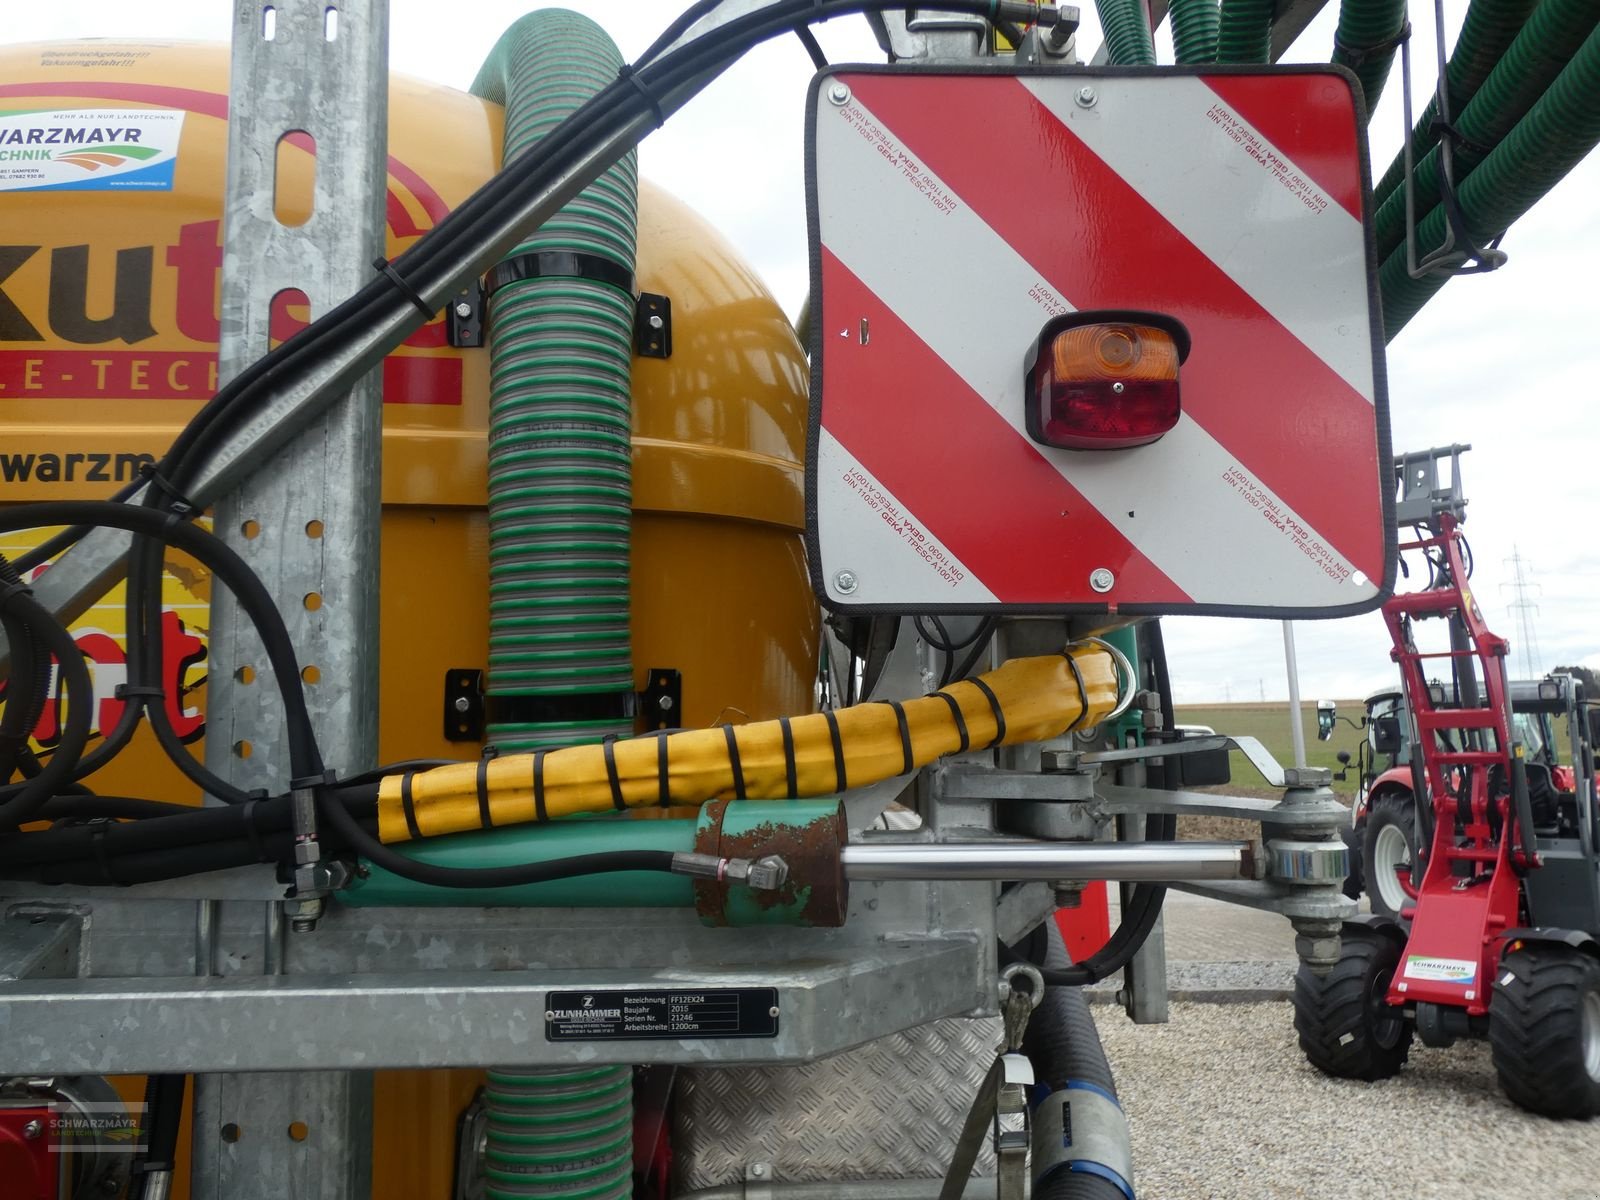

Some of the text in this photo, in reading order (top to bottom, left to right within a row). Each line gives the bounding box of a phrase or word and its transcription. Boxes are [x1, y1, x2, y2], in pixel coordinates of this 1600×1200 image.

[846, 103, 871, 127] A10071
[1212, 104, 1239, 128] A10071
[870, 126, 894, 150] TPESC
[1237, 126, 1262, 150] TPESC
[840, 109, 854, 123] DIN
[854, 122, 873, 141] 11030
[877, 145, 898, 166] GEKA
[902, 168, 926, 192] TPESC
[925, 192, 951, 215] A10071
[899, 152, 919, 173] GEKA
[1206, 110, 1221, 124] DIN
[1222, 124, 1242, 142] 11030
[1245, 145, 1267, 166] GEKA
[1271, 168, 1296, 192] TPESC
[1295, 191, 1322, 215] A10071
[1267, 152, 1288, 173] GEKA
[923, 176, 943, 196] 11030
[1292, 175, 1313, 195] 11030
[942, 195, 957, 210] DIN
[1313, 194, 1328, 209] DIN
[1028, 289, 1043, 303] DIN
[1034, 283, 1060, 307] A10071
[849, 467, 875, 493] A10071
[1228, 466, 1256, 491] A10071
[874, 492, 899, 517] TPESC
[1255, 490, 1281, 515] TPESC
[843, 474, 857, 488] DIN
[858, 488, 877, 509] 11030
[881, 512, 903, 534] GEKA
[908, 537, 932, 562] TPESC
[931, 562, 958, 587] A10071
[904, 520, 925, 542] GEKA
[1222, 473, 1238, 487] DIN
[1238, 486, 1259, 507] 11030
[1263, 510, 1286, 532] GEKA
[1290, 534, 1317, 560] TPESC
[1316, 559, 1344, 584] A10071
[1286, 517, 1308, 540] GEKA
[929, 545, 949, 566] 11030
[1312, 542, 1334, 563] 11030
[949, 565, 964, 581] DIN
[1334, 562, 1350, 578] DIN
[554, 1009, 620, 1018] ZUNHAMMER
